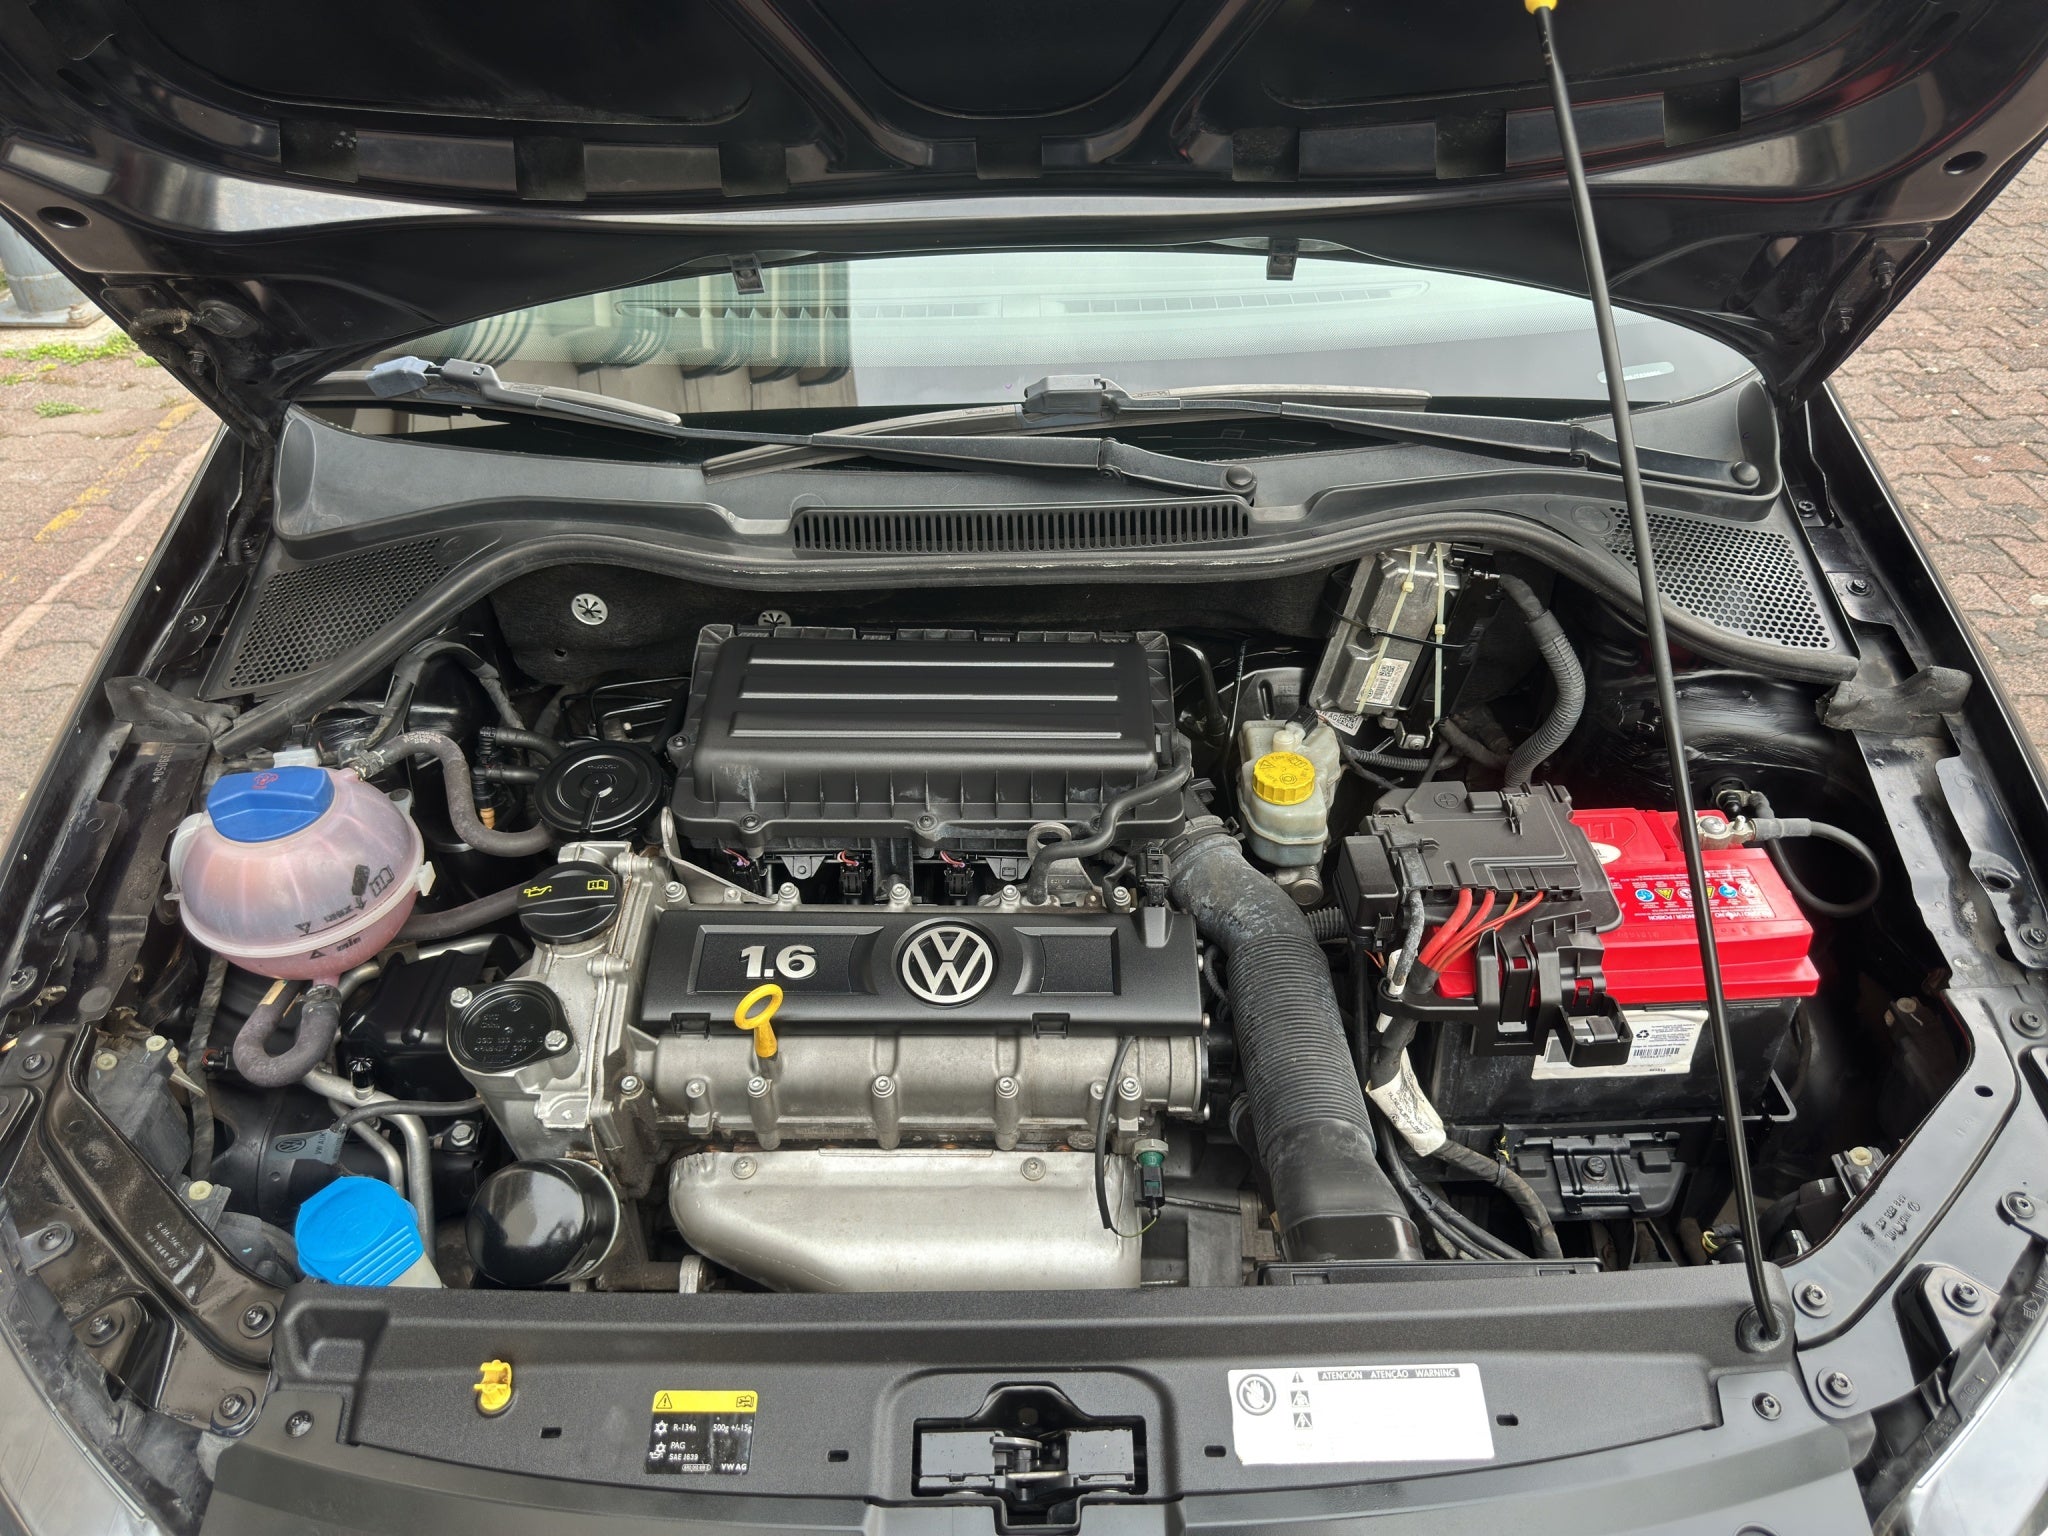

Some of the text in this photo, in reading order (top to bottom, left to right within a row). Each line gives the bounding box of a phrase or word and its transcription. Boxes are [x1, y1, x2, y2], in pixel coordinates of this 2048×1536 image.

[740, 926, 994, 1004] 1.6 VW
[1321, 1369, 1363, 1380] ATENCIÓN
[1414, 1367, 1456, 1378] WARNING
[673, 1423, 697, 1432] R-134a
[713, 1423, 729, 1433] 500g
[670, 1441, 686, 1449] PAG
[669, 1453, 682, 1461] SAE
